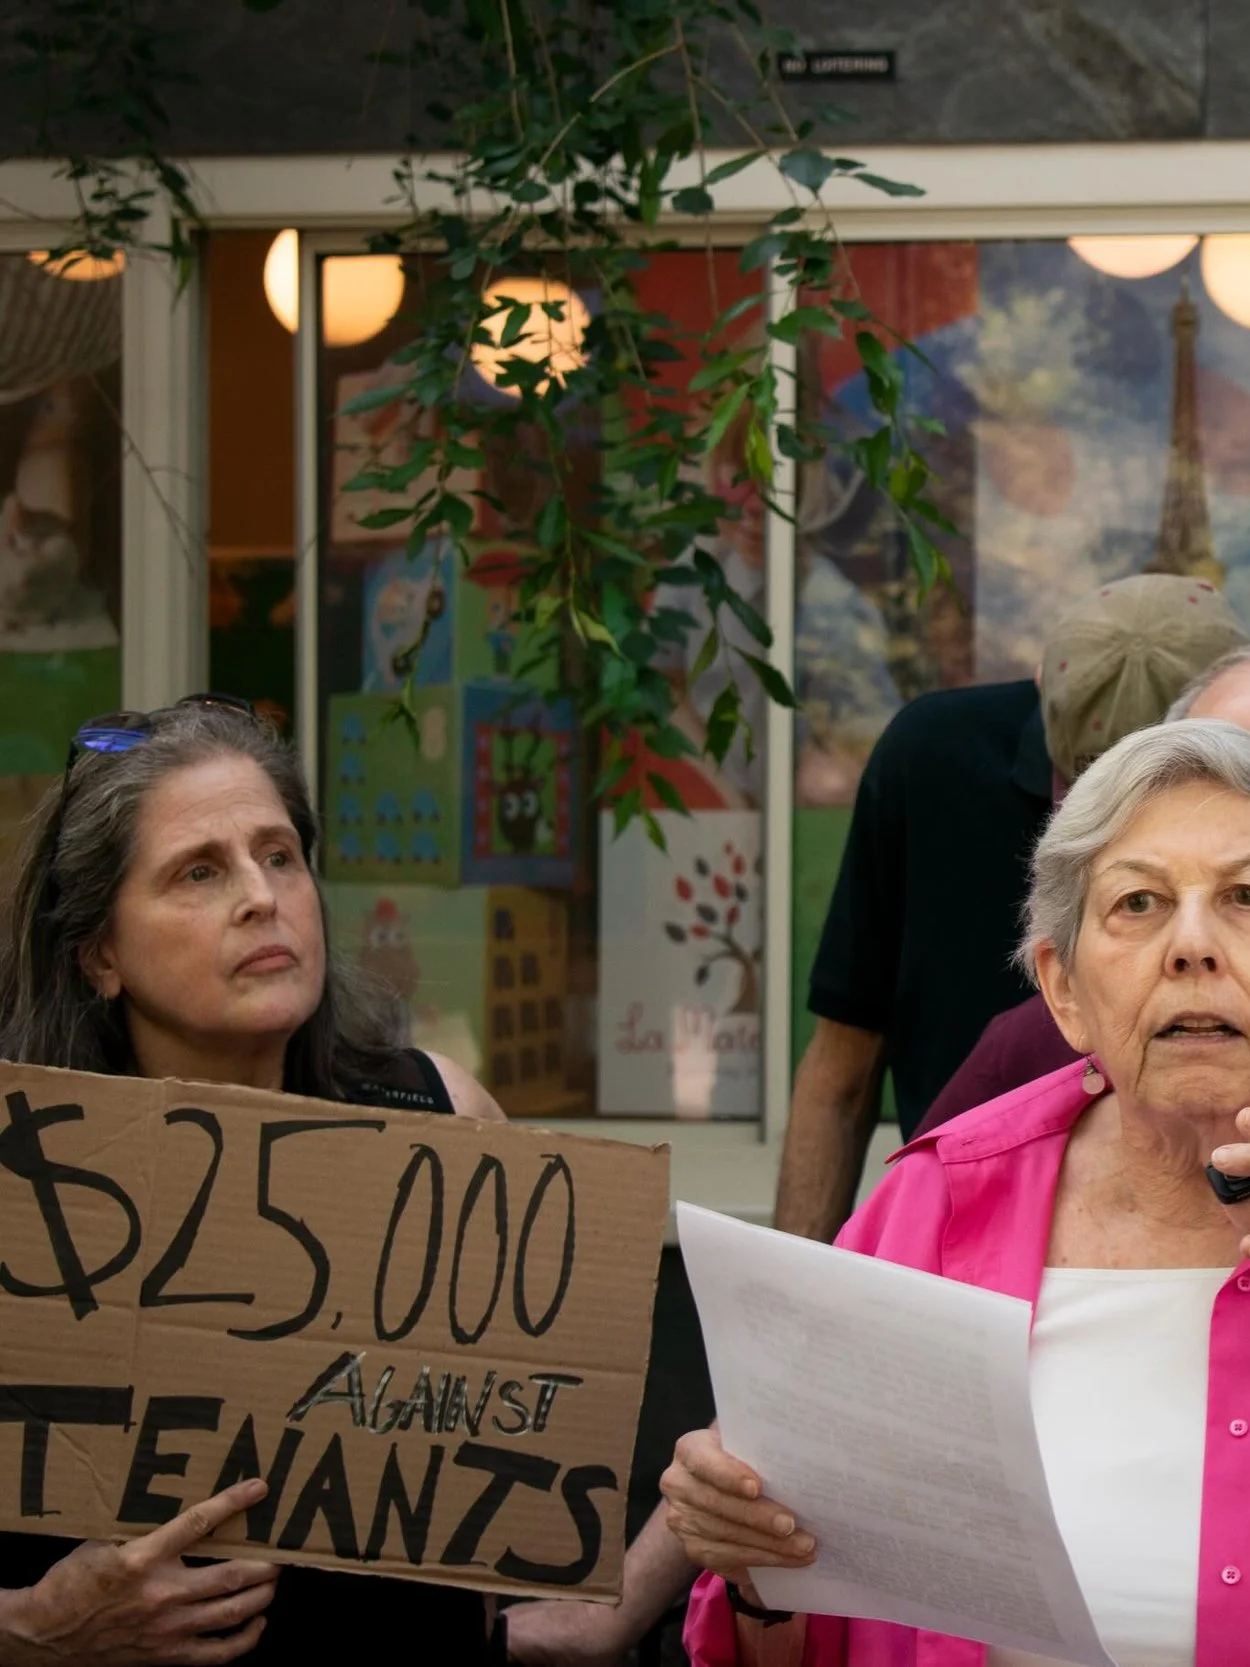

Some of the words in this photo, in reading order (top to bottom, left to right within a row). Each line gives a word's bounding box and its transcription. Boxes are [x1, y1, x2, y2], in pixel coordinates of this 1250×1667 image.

[0, 1090, 575, 1344] $25,000
[0, 1384, 620, 1585] TENANTS
[286, 1351, 583, 1436] AGAINST
